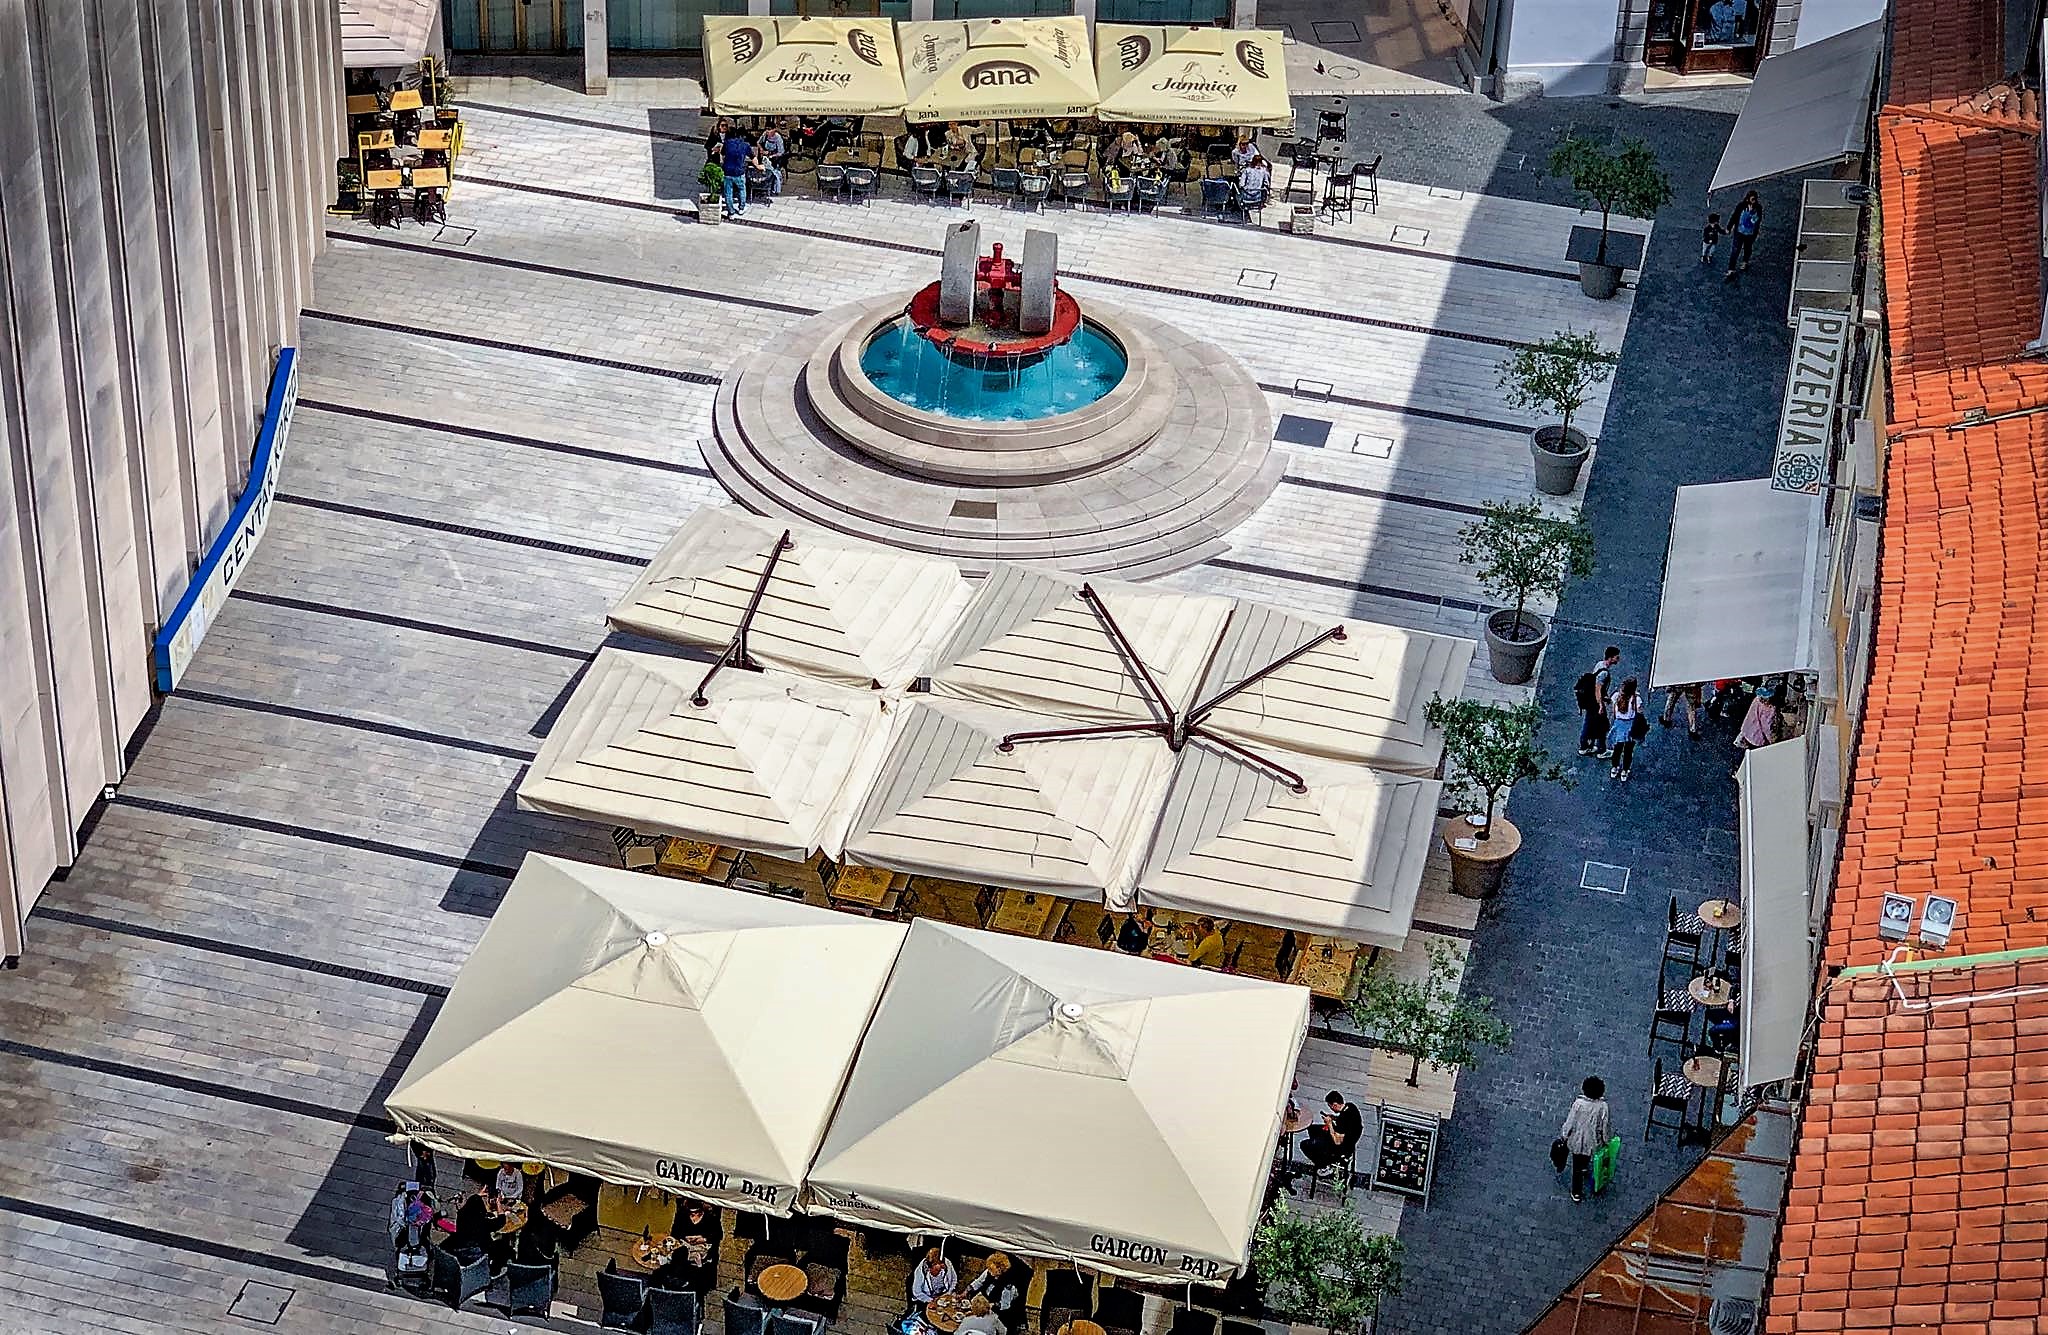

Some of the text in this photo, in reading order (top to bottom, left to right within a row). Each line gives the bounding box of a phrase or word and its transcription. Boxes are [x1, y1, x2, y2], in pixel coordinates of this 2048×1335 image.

[766, 68, 853, 84] Jamnica
[966, 66, 1035, 90] Jana
[1152, 77, 1239, 93] Jamnica
[1784, 316, 1843, 446] PIZZERIA
[222, 467, 274, 586] CENTAR
[656, 1159, 730, 1191] GARCON
[1090, 1234, 1220, 1280] GARCON BAR
